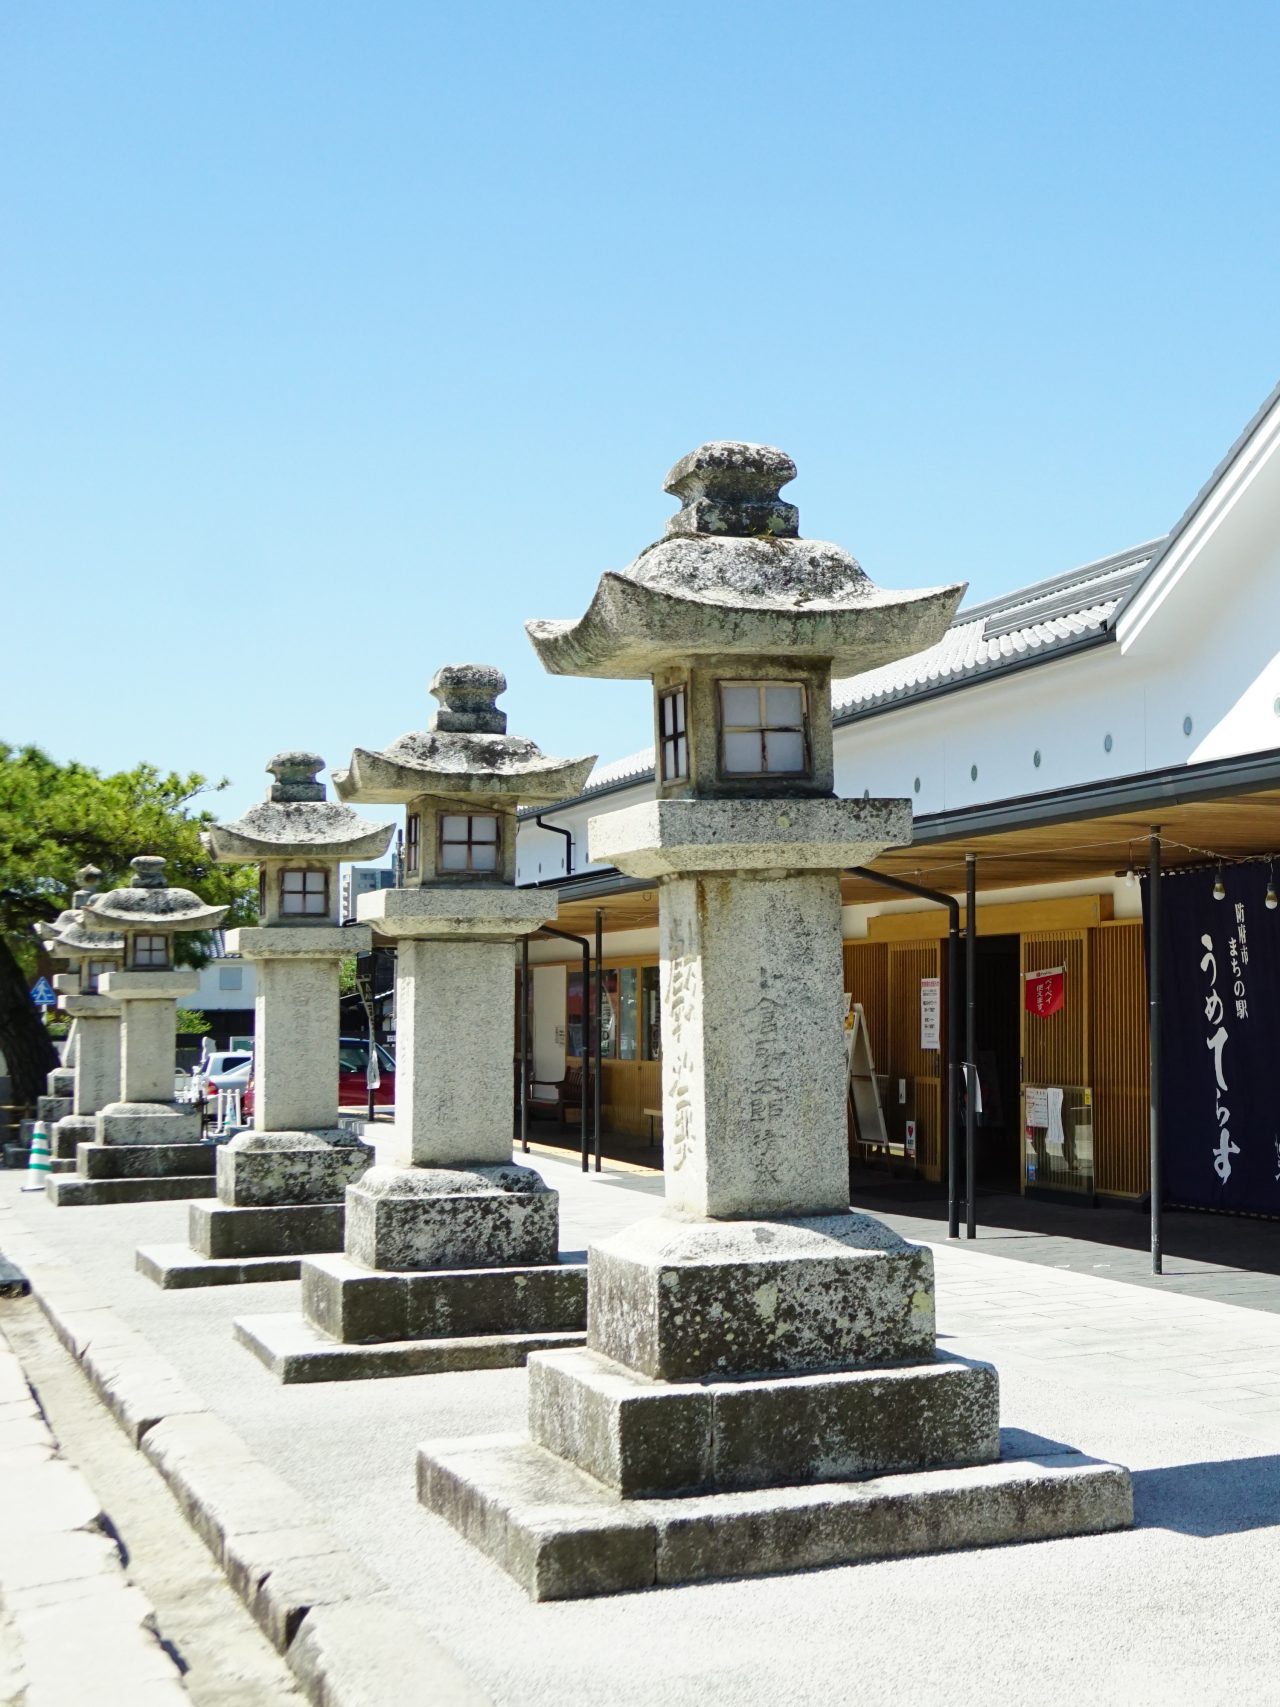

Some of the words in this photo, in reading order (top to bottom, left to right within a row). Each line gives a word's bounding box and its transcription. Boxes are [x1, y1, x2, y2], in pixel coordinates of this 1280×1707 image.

[1200, 933, 1241, 1186] うめてらす
